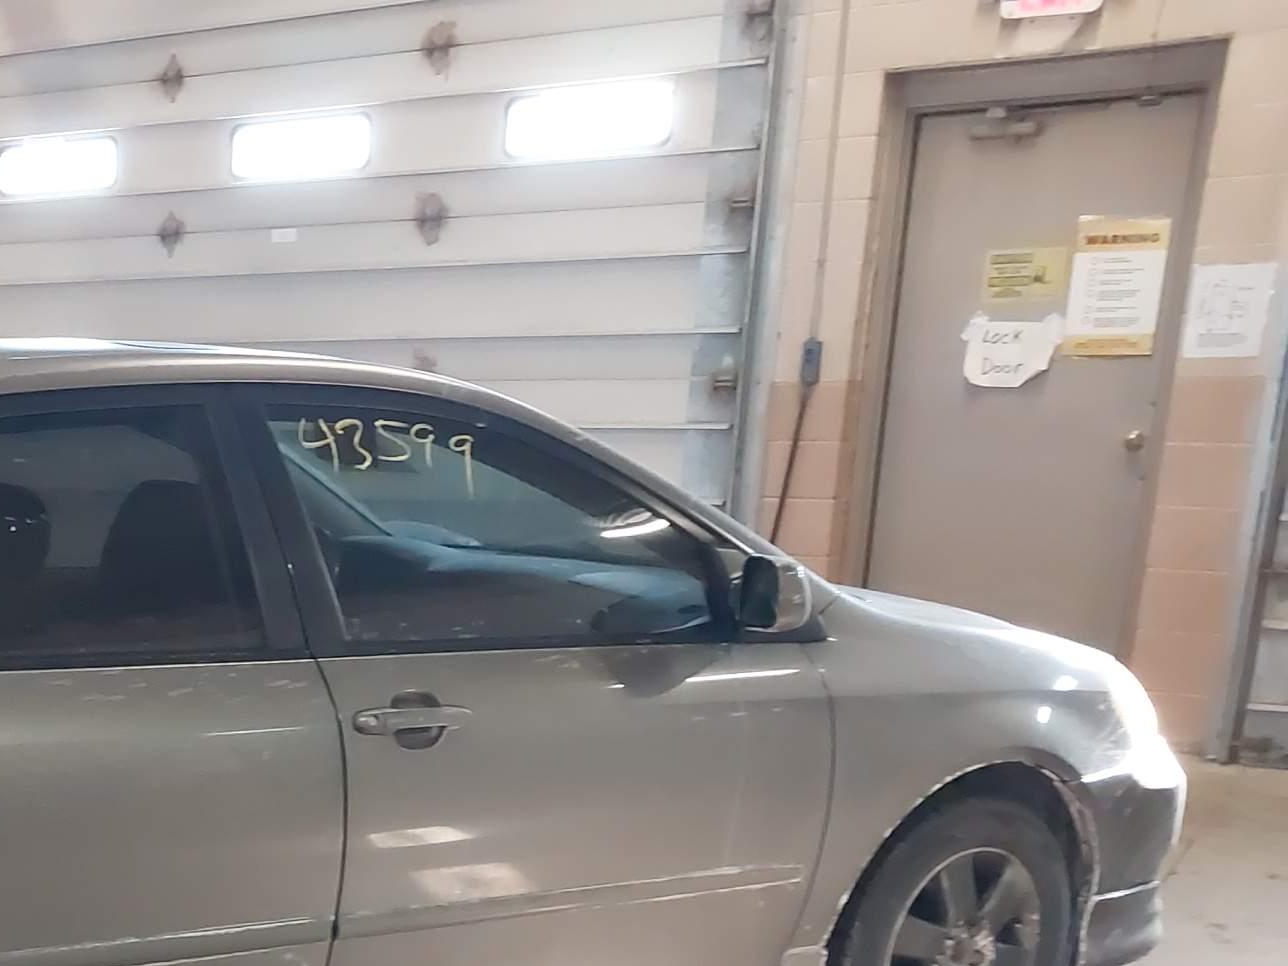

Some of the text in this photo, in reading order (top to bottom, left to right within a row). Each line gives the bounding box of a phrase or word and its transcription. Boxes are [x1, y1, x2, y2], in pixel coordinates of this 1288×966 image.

[1084, 232, 1161, 246] WARNING
[980, 357, 1025, 376] Door
[297, 416, 475, 500] 43599
